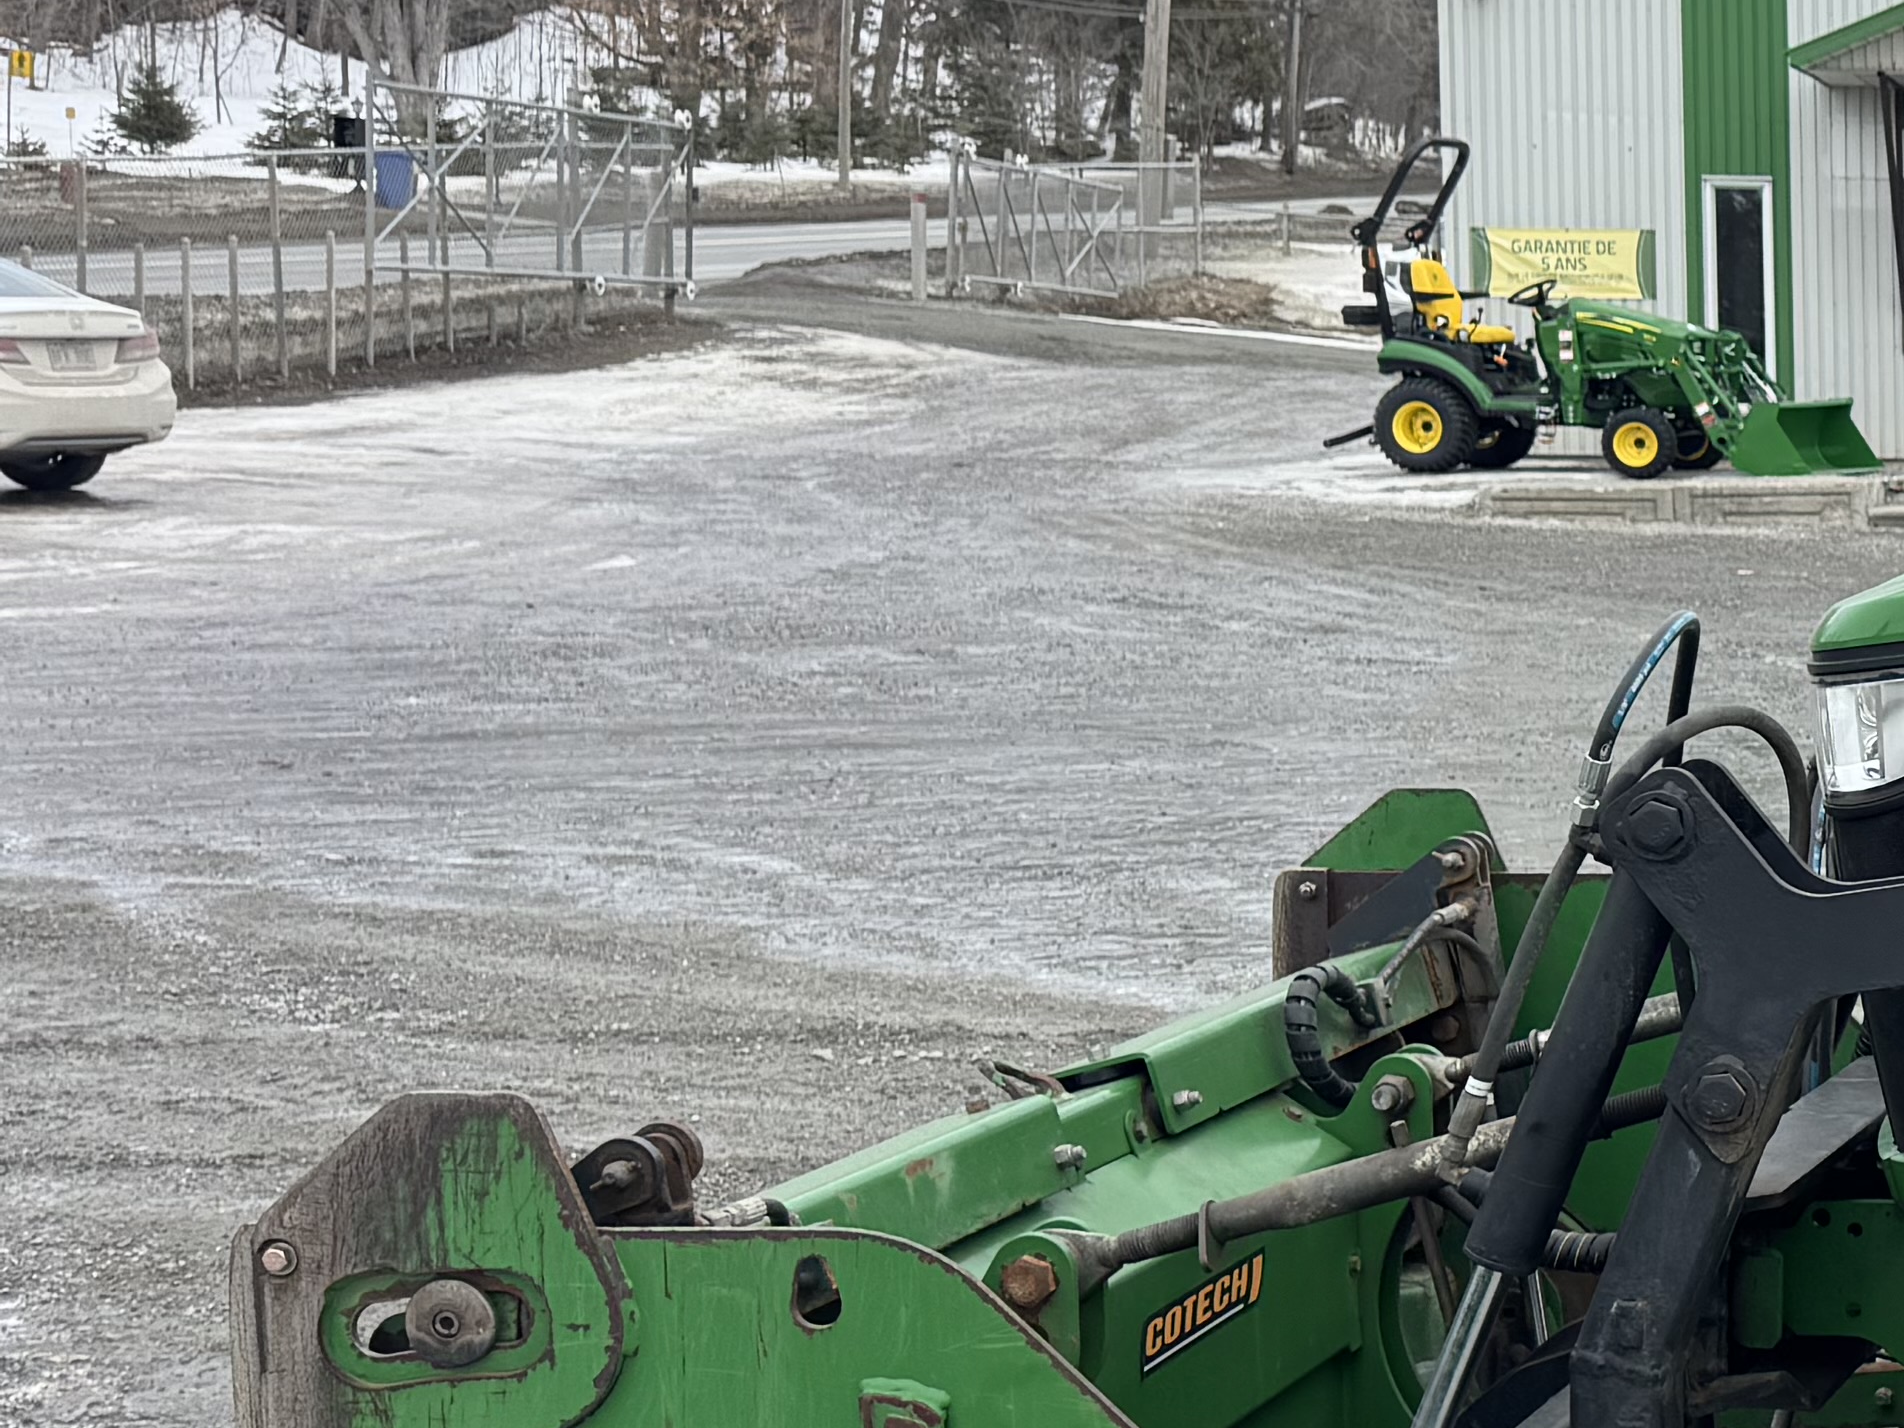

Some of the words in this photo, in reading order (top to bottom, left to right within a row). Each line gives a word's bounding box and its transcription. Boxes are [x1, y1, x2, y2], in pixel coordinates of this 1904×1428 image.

[1511, 238, 1591, 255] GARANTIE
[1596, 240, 1616, 256] DE
[1541, 256, 1550, 271] 5
[1554, 257, 1588, 272] ANS
[1146, 1262, 1250, 1358] COTECH
